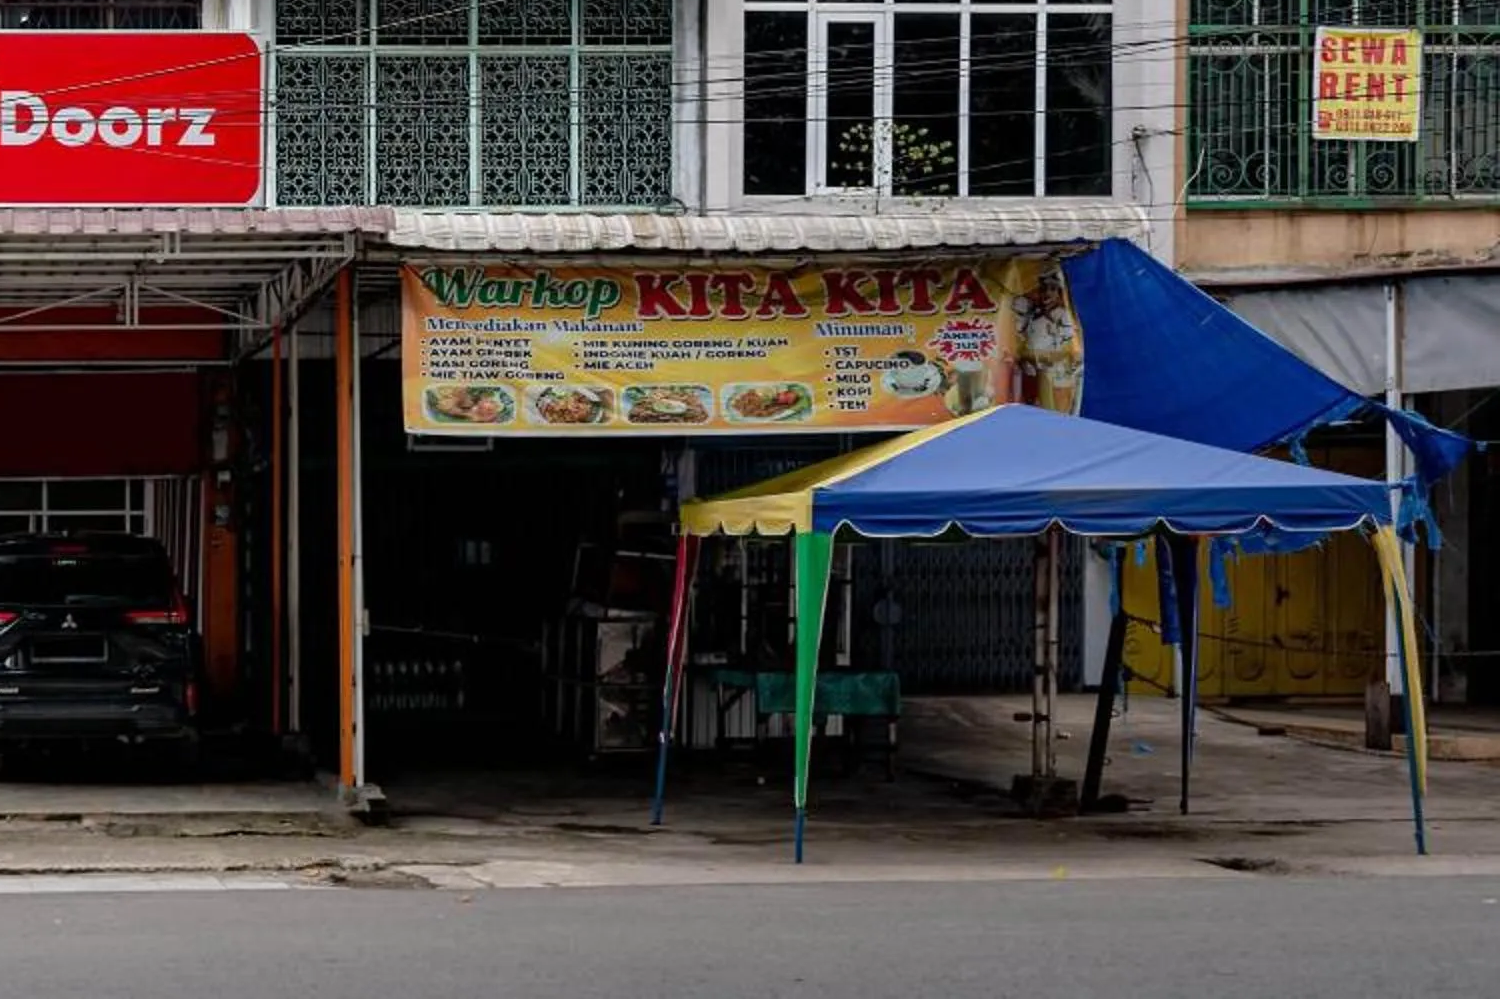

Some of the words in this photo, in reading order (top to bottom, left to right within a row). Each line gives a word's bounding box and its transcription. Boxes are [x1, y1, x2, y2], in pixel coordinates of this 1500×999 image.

[1320, 37, 1407, 66] SEWA
[1319, 72, 1409, 102] RENT
[421, 266, 621, 321] Warkop
[634, 270, 811, 321] KITA
[821, 267, 998, 316] KITA
[429, 338, 471, 346] AYAM
[955, 341, 979, 350] JUS
[429, 348, 473, 357] AYAM
[650, 350, 691, 359] KUAH
[583, 362, 610, 370] MIE
[430, 371, 457, 379] MIE
[461, 371, 500, 379] TIAW
[835, 373, 871, 384] MILO
[836, 387, 872, 397] KOPI
[838, 400, 867, 410] TEH
